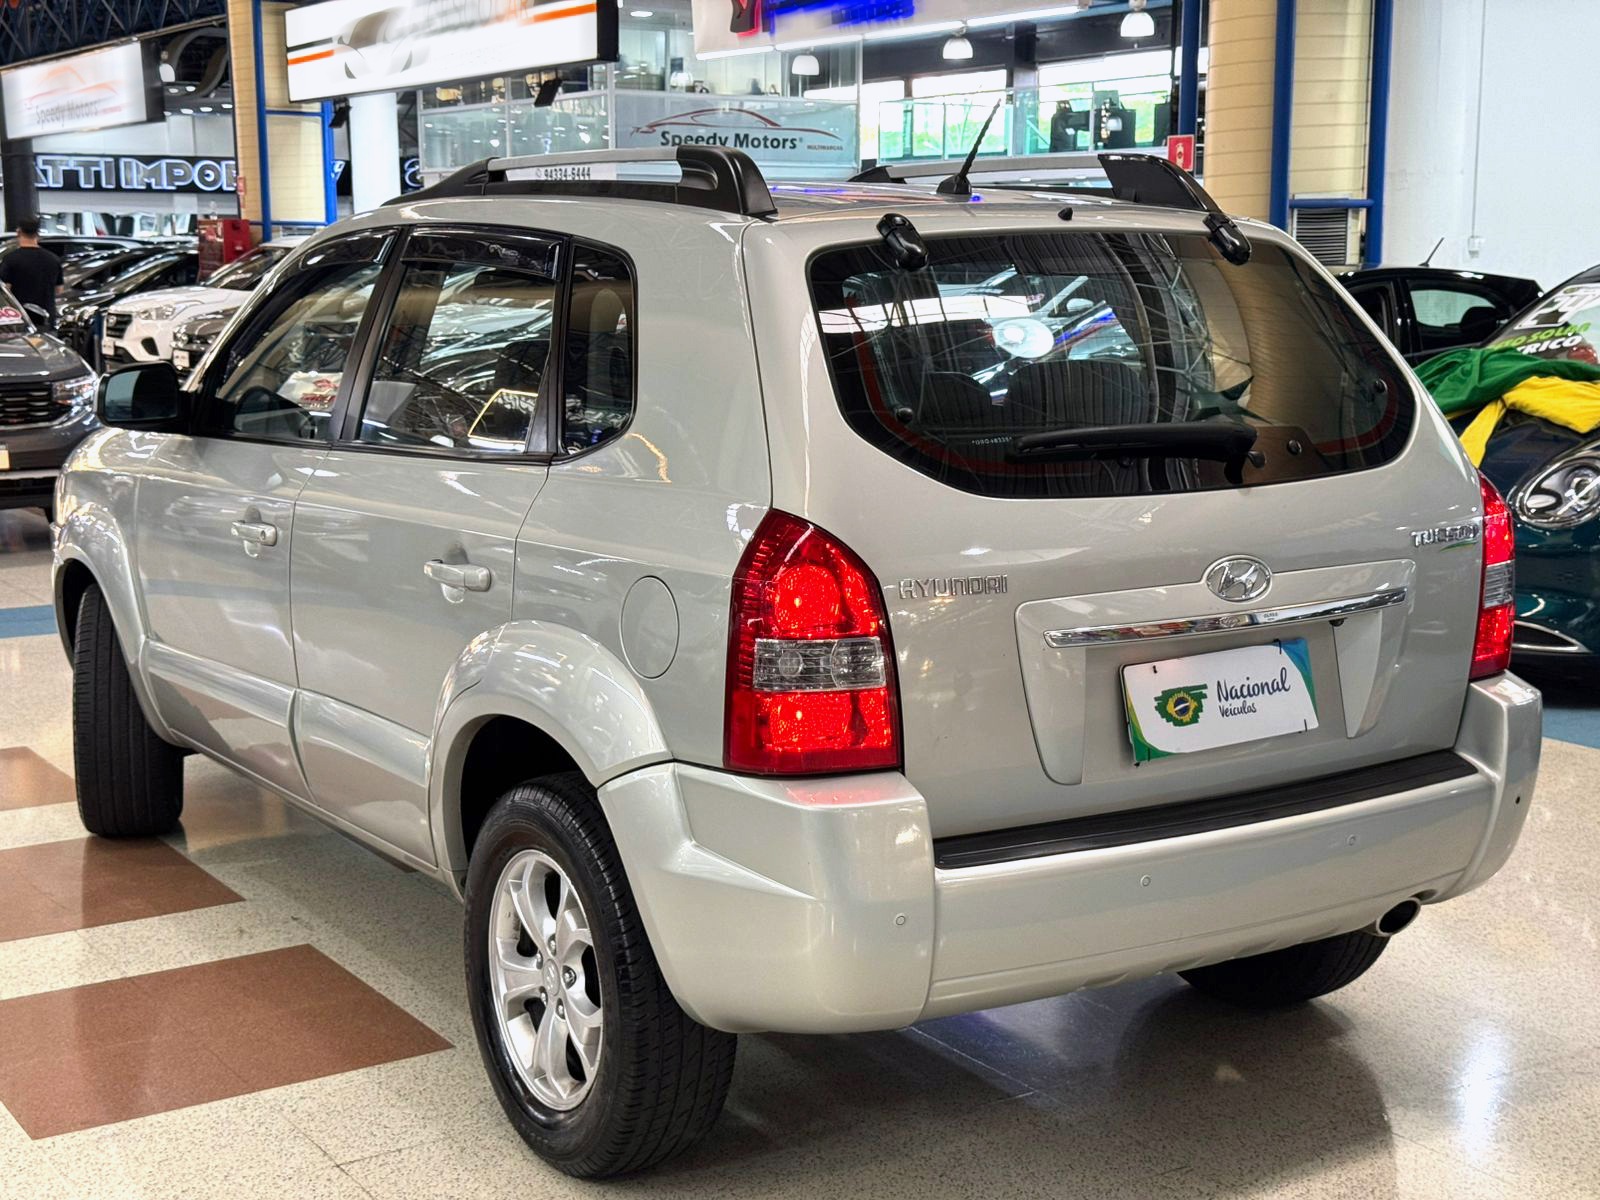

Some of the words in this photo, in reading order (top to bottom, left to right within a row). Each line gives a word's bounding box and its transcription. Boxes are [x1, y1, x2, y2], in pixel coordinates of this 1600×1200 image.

[660, 131, 728, 147] Speedy
[1410, 524, 1478, 546] TUCSON
[899, 575, 1008, 599] HYUNDAI
[1216, 667, 1291, 703] Nacional
